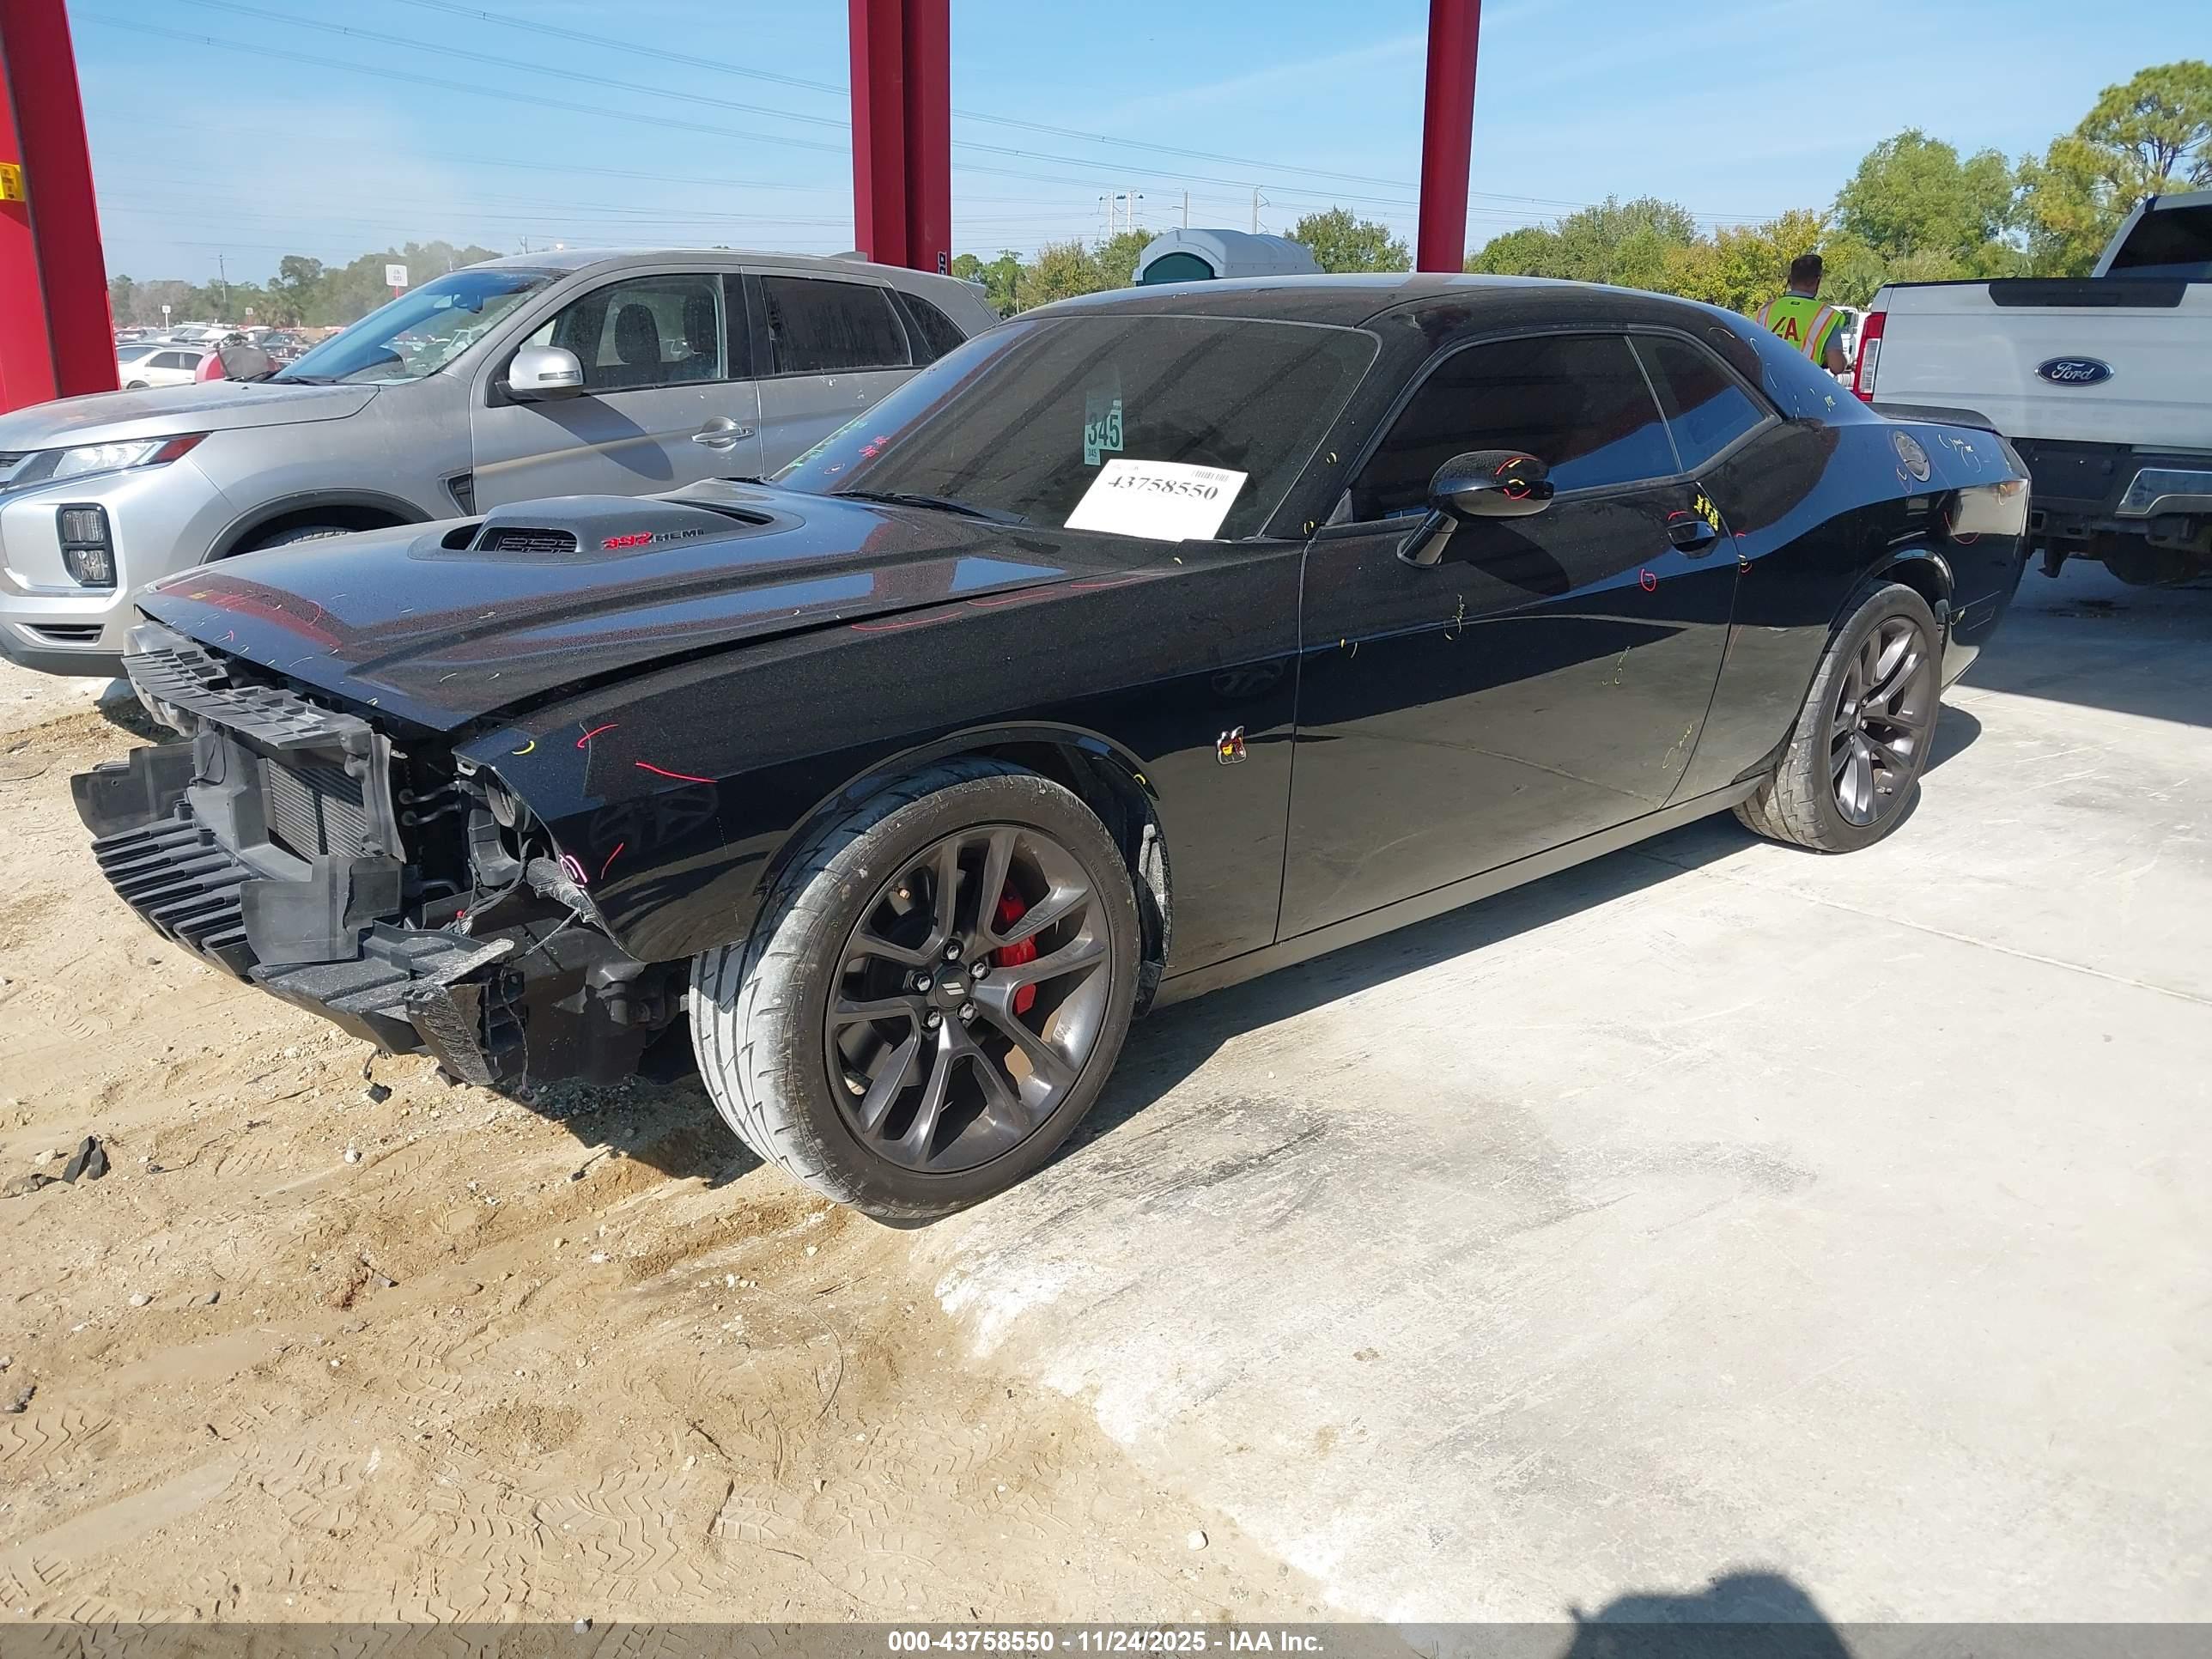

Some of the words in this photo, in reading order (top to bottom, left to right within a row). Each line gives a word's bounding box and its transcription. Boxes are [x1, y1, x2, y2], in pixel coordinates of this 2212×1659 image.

[2051, 362, 2095, 380] Ford
[1088, 413, 1121, 448] 345
[1108, 475, 1218, 501] 43758550
[601, 531, 653, 550] 392
[652, 528, 705, 543] HEMI
